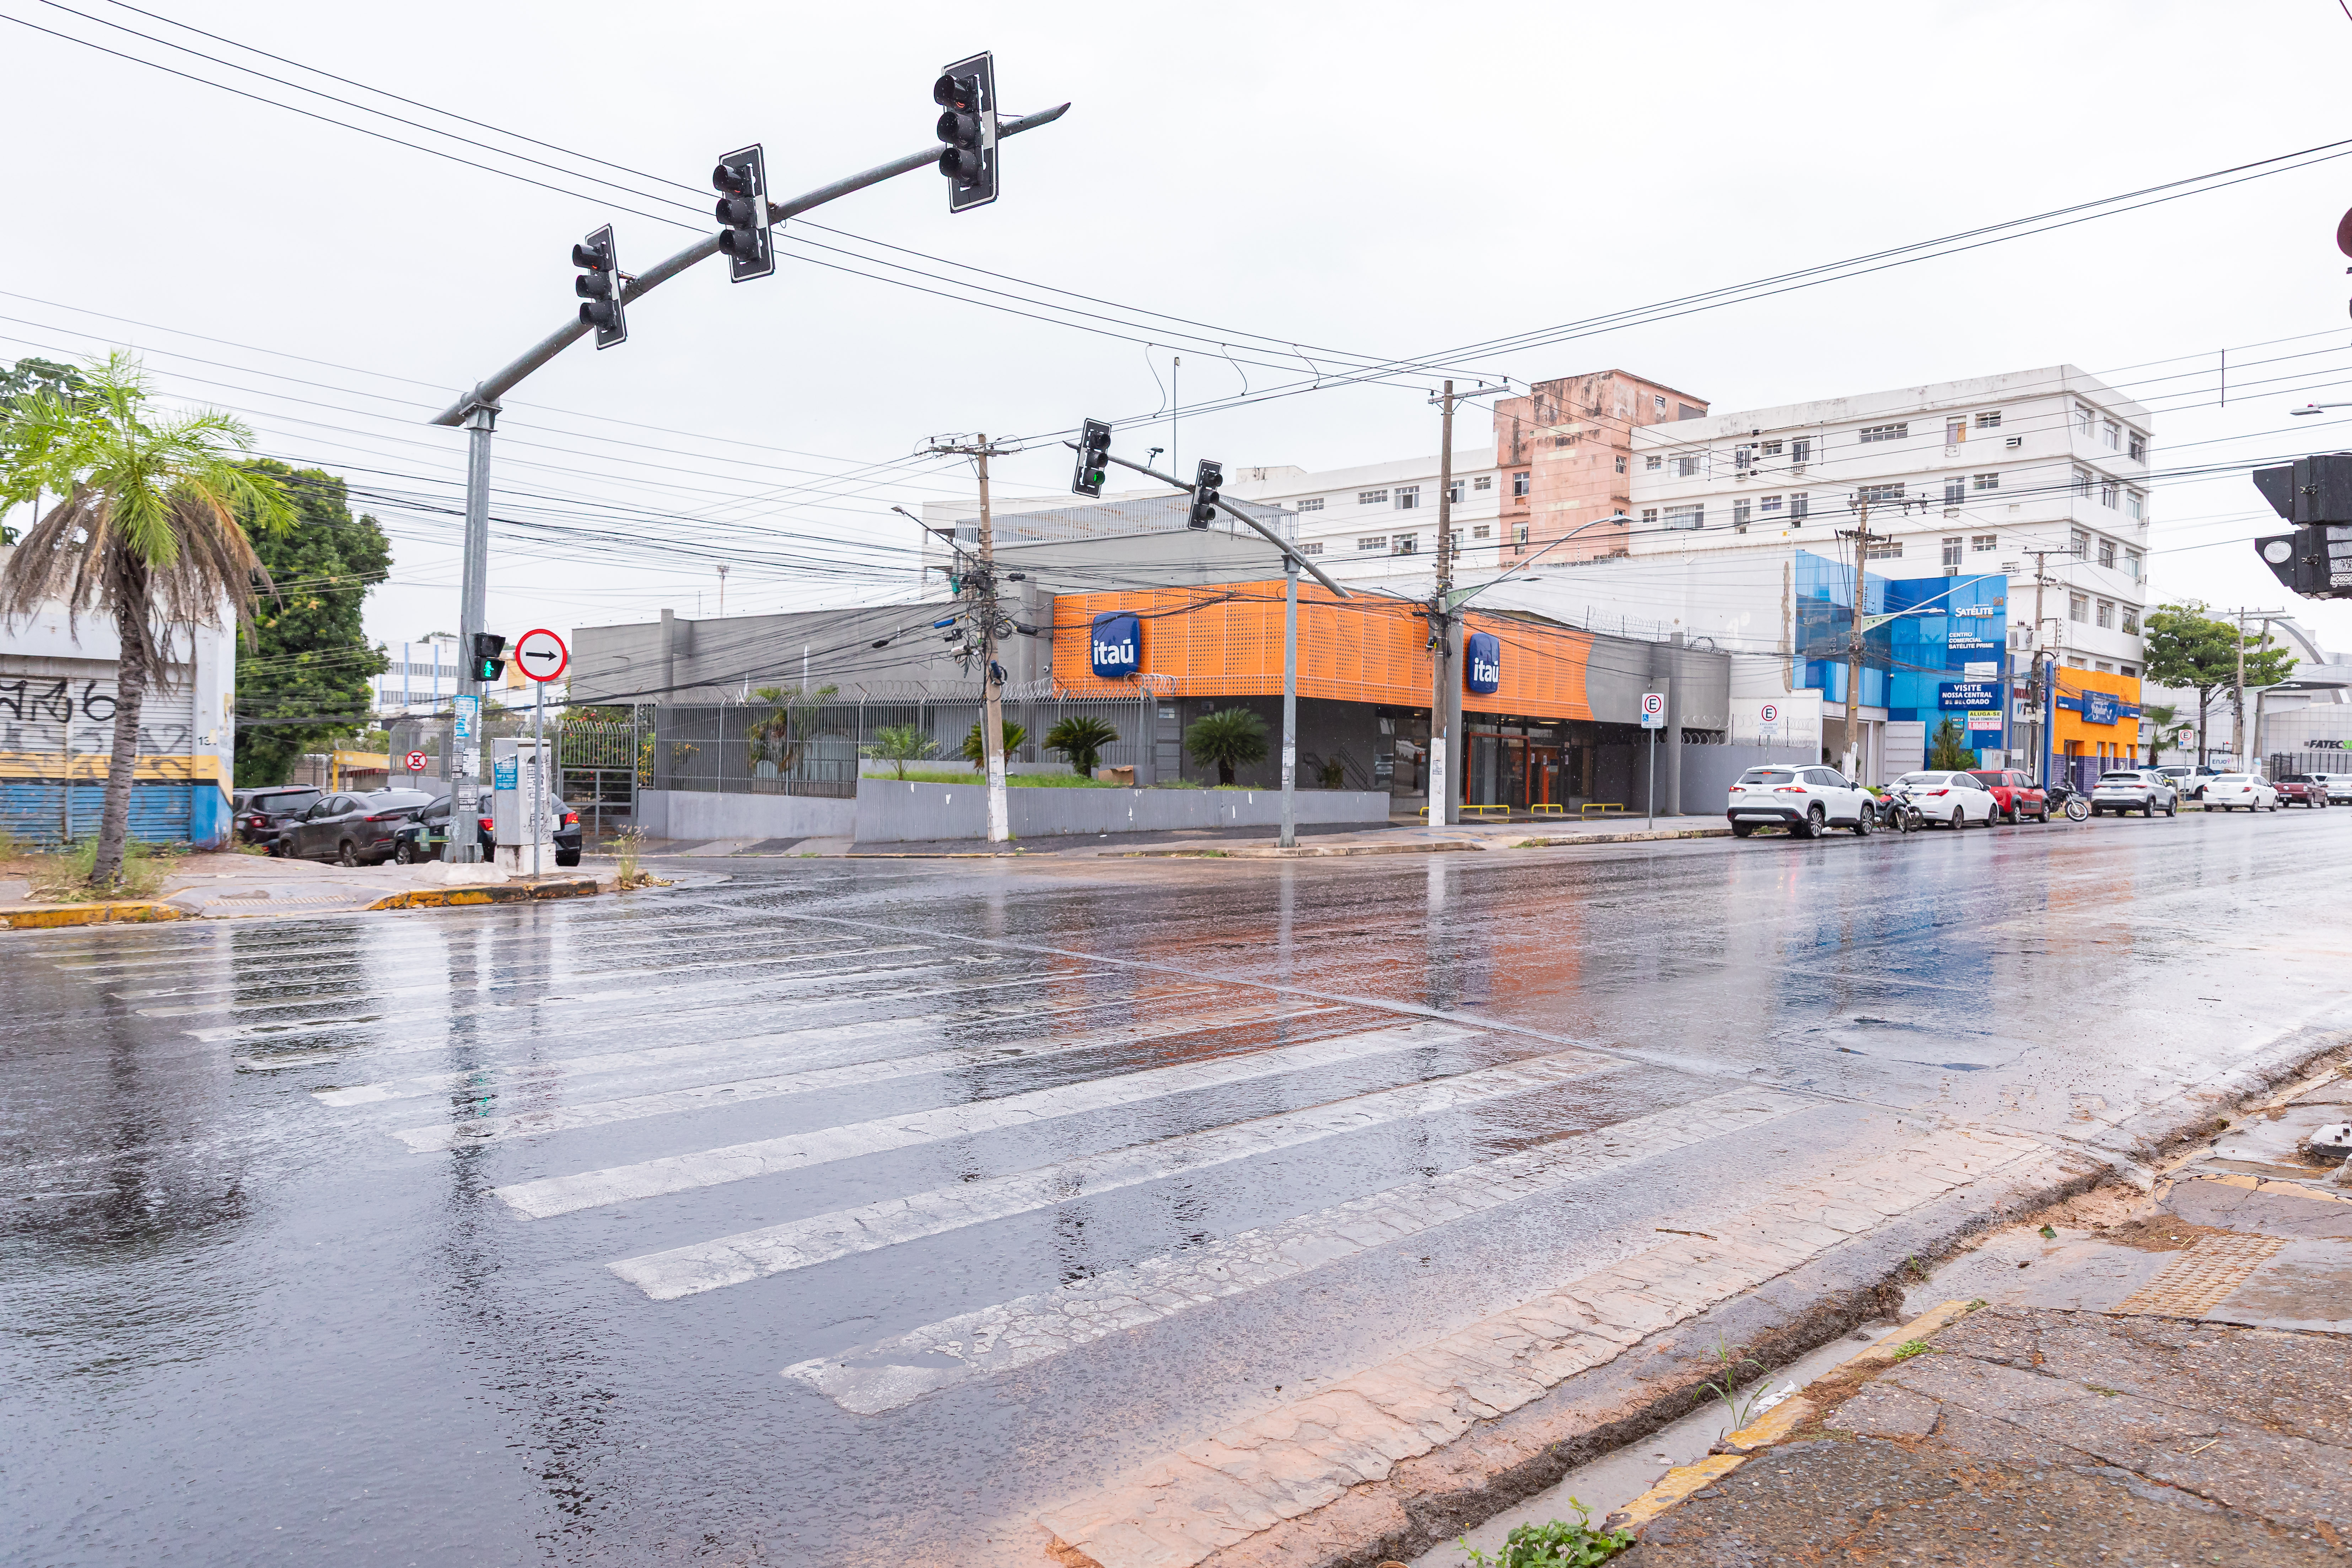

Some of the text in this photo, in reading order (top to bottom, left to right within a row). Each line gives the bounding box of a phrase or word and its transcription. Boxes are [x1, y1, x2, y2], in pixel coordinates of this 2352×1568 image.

[1955, 606, 1993, 617] SATÉLITE
[1094, 638, 1134, 665] itaú
[1474, 657, 1499, 683] itaú
[1649, 699, 1656, 710] E
[1766, 708, 1772, 718] E
